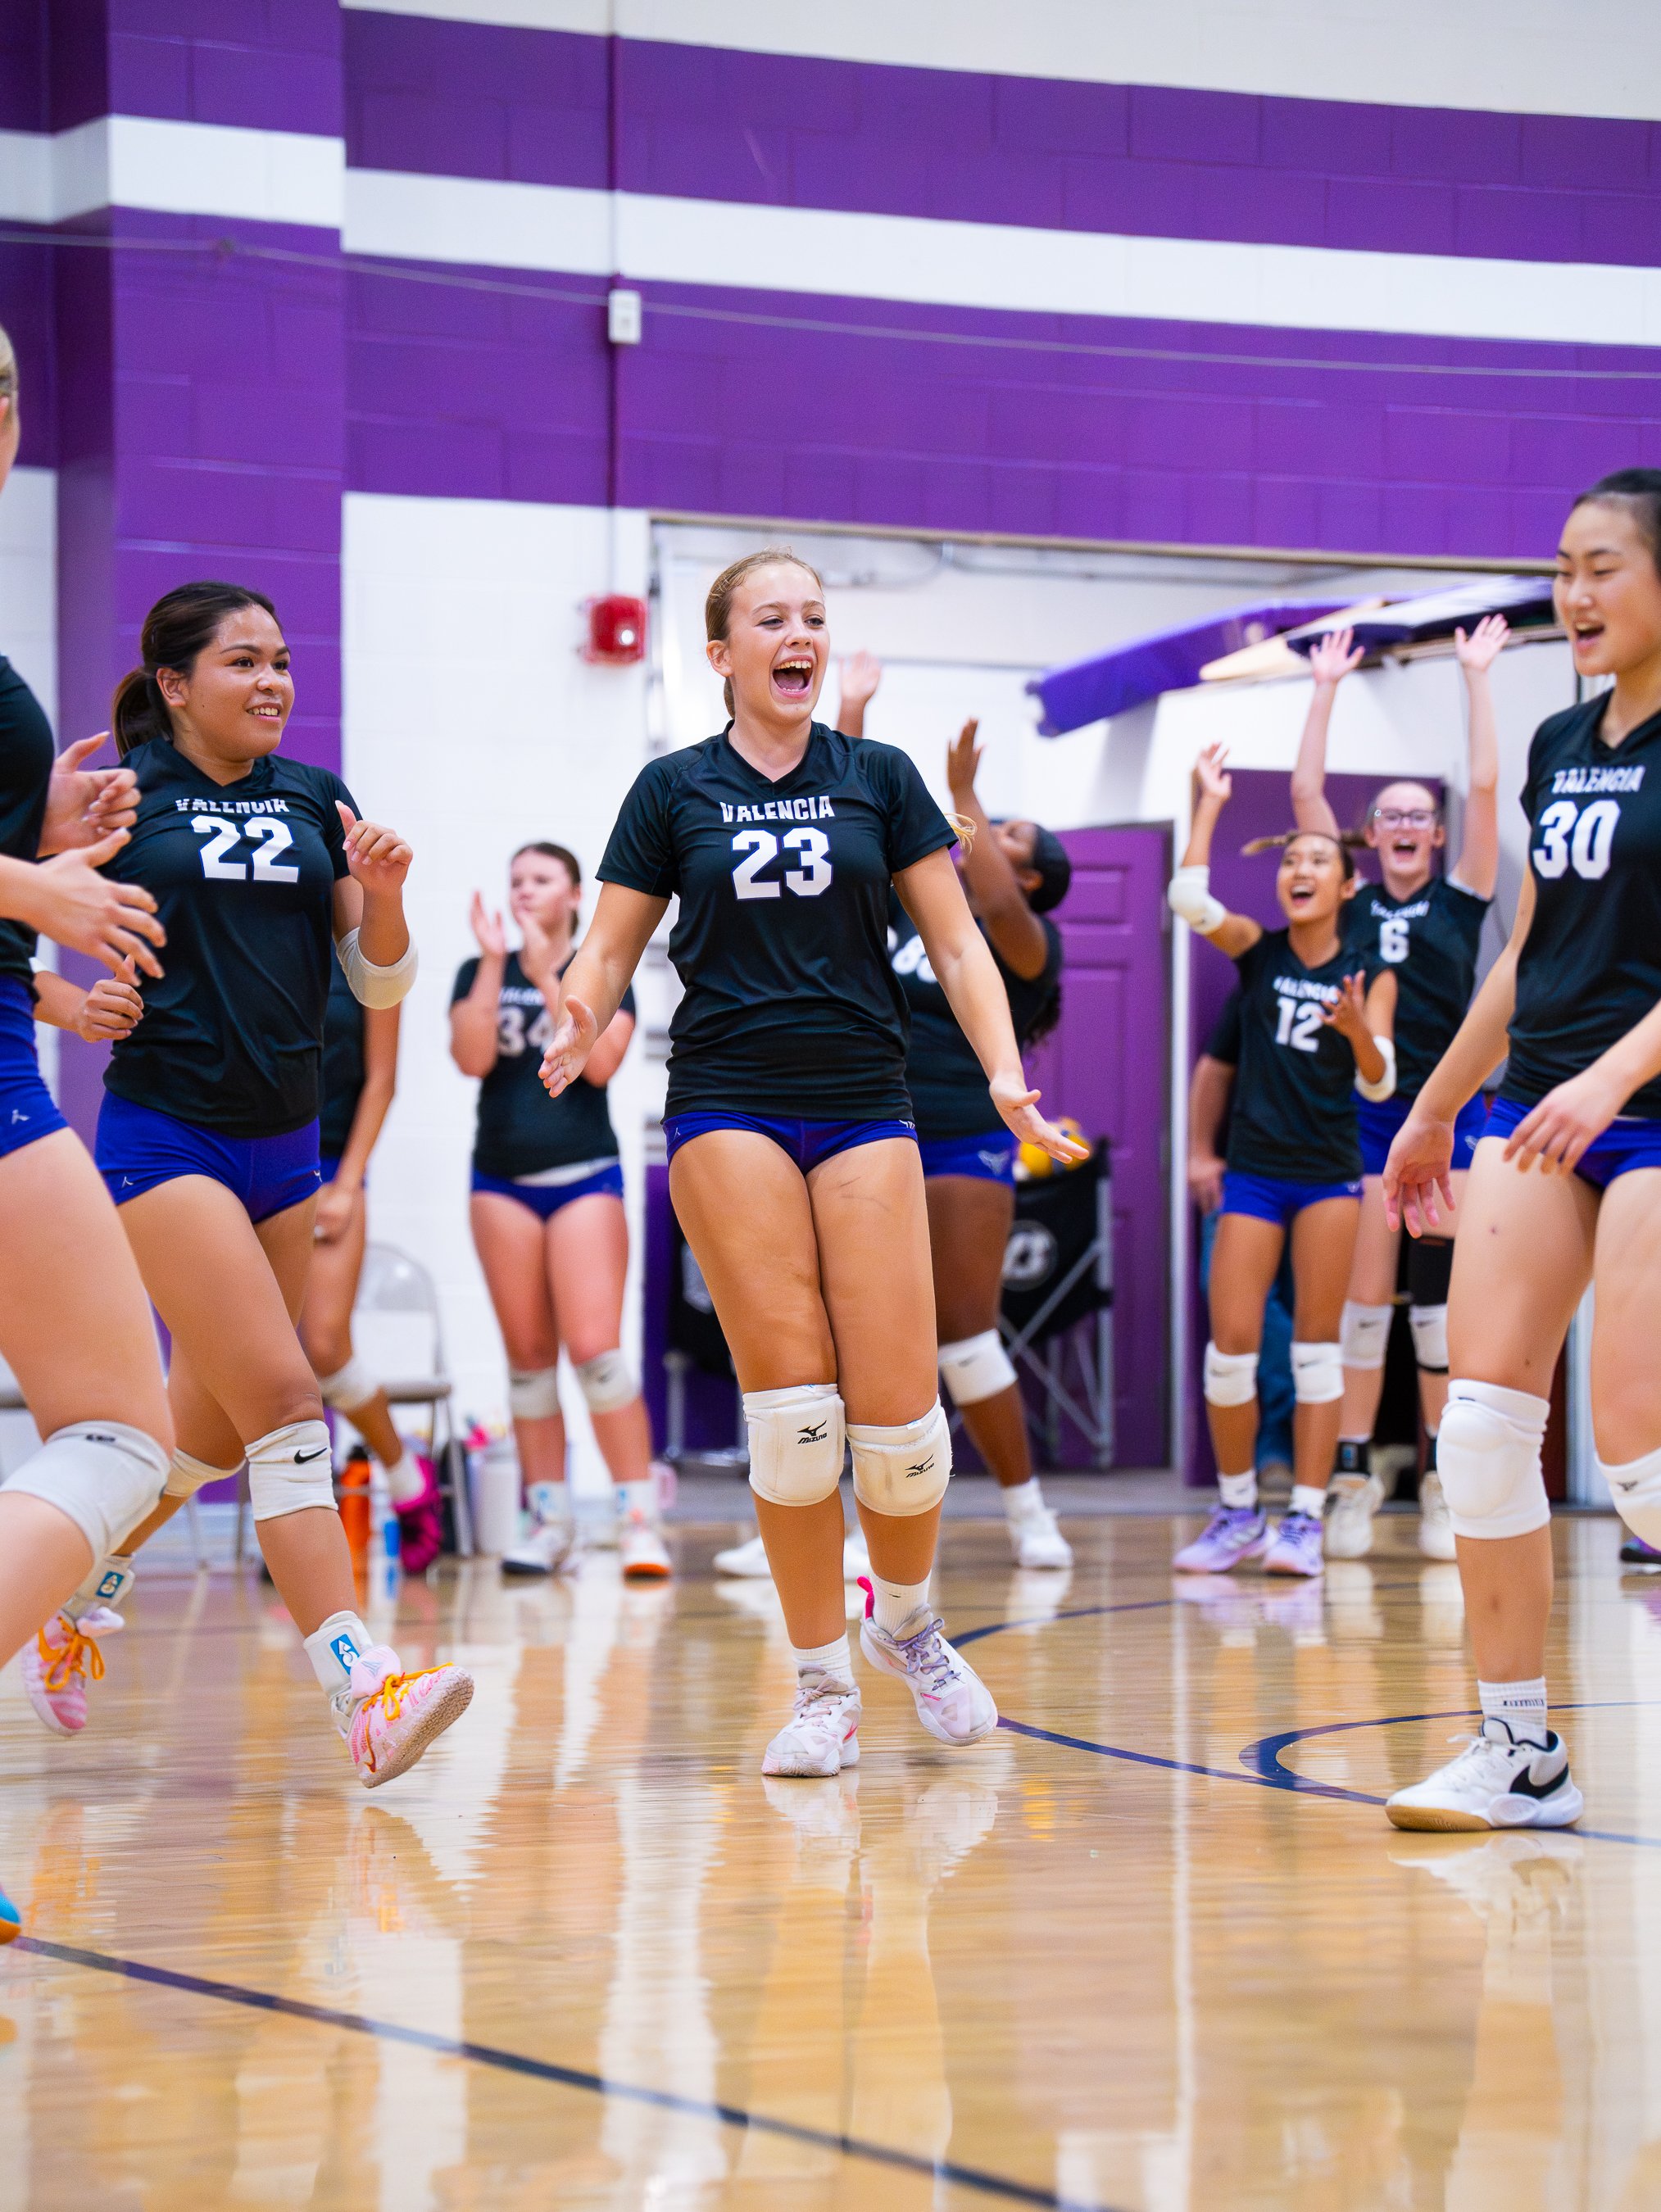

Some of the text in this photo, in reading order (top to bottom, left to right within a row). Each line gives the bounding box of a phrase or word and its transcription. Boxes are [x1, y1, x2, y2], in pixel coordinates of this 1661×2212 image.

[719, 796, 835, 823] VALENCIA
[1532, 800, 1622, 880] 30
[190, 815, 300, 883] 22
[731, 827, 833, 900] 23
[1380, 918, 1409, 963] 6
[1275, 996, 1325, 1053] 12
